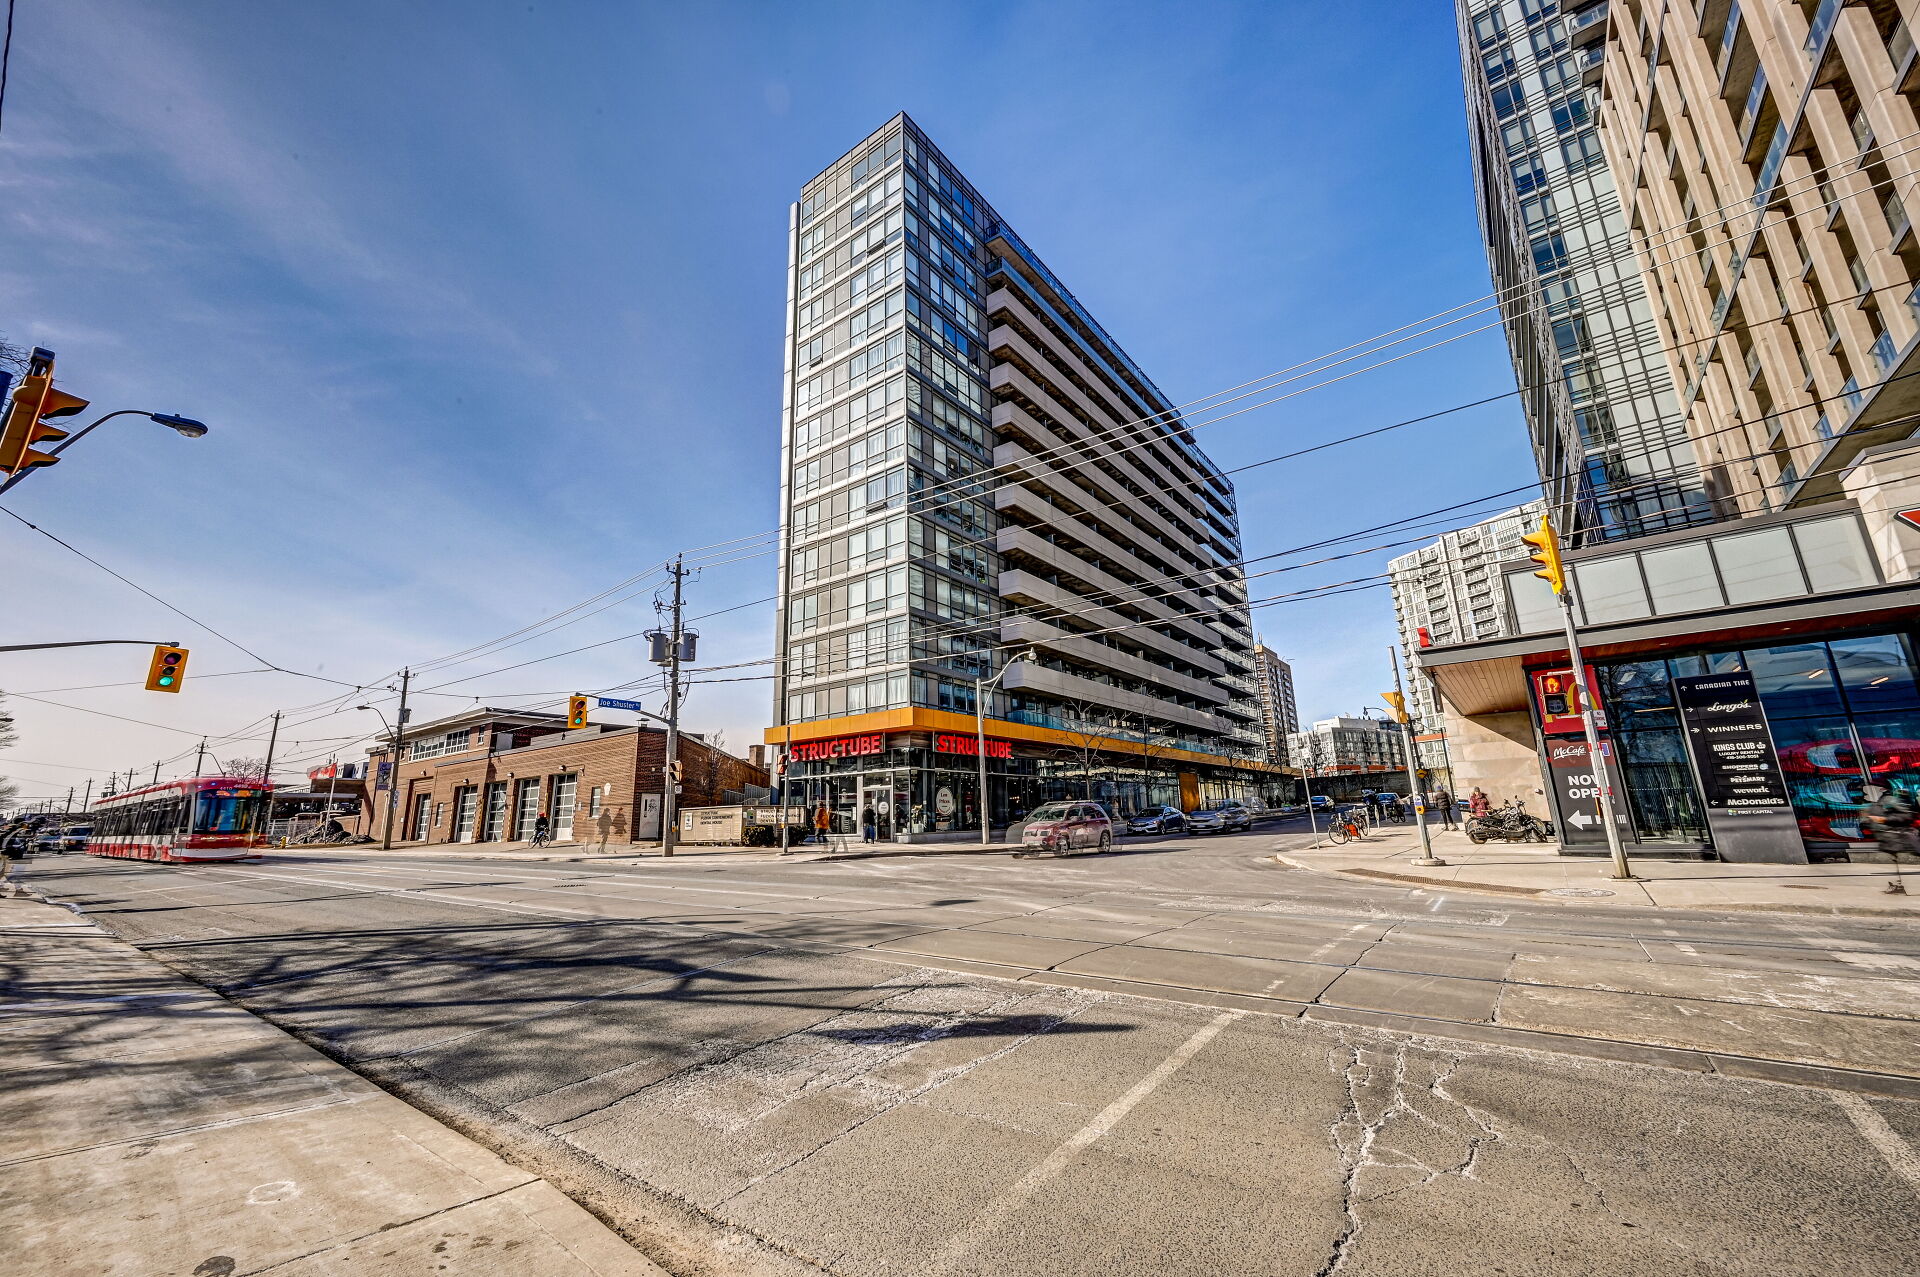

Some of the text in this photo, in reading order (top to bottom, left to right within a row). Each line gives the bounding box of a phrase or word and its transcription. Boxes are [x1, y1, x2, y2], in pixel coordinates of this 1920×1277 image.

[1695, 682, 1732, 690] CANADIAN
[600, 699, 610, 707] Joe
[612, 700, 635, 708] Shuster
[1708, 699, 1752, 712] Longo's
[1707, 724, 1762, 733] WINNERS
[790, 735, 882, 762] STRUCTUBE
[937, 734, 1012, 758] STRUCTUBE
[1713, 743, 1736, 751] KINGS
[1568, 788, 1601, 799] OPE
[1728, 798, 1784, 806] McDonald's
